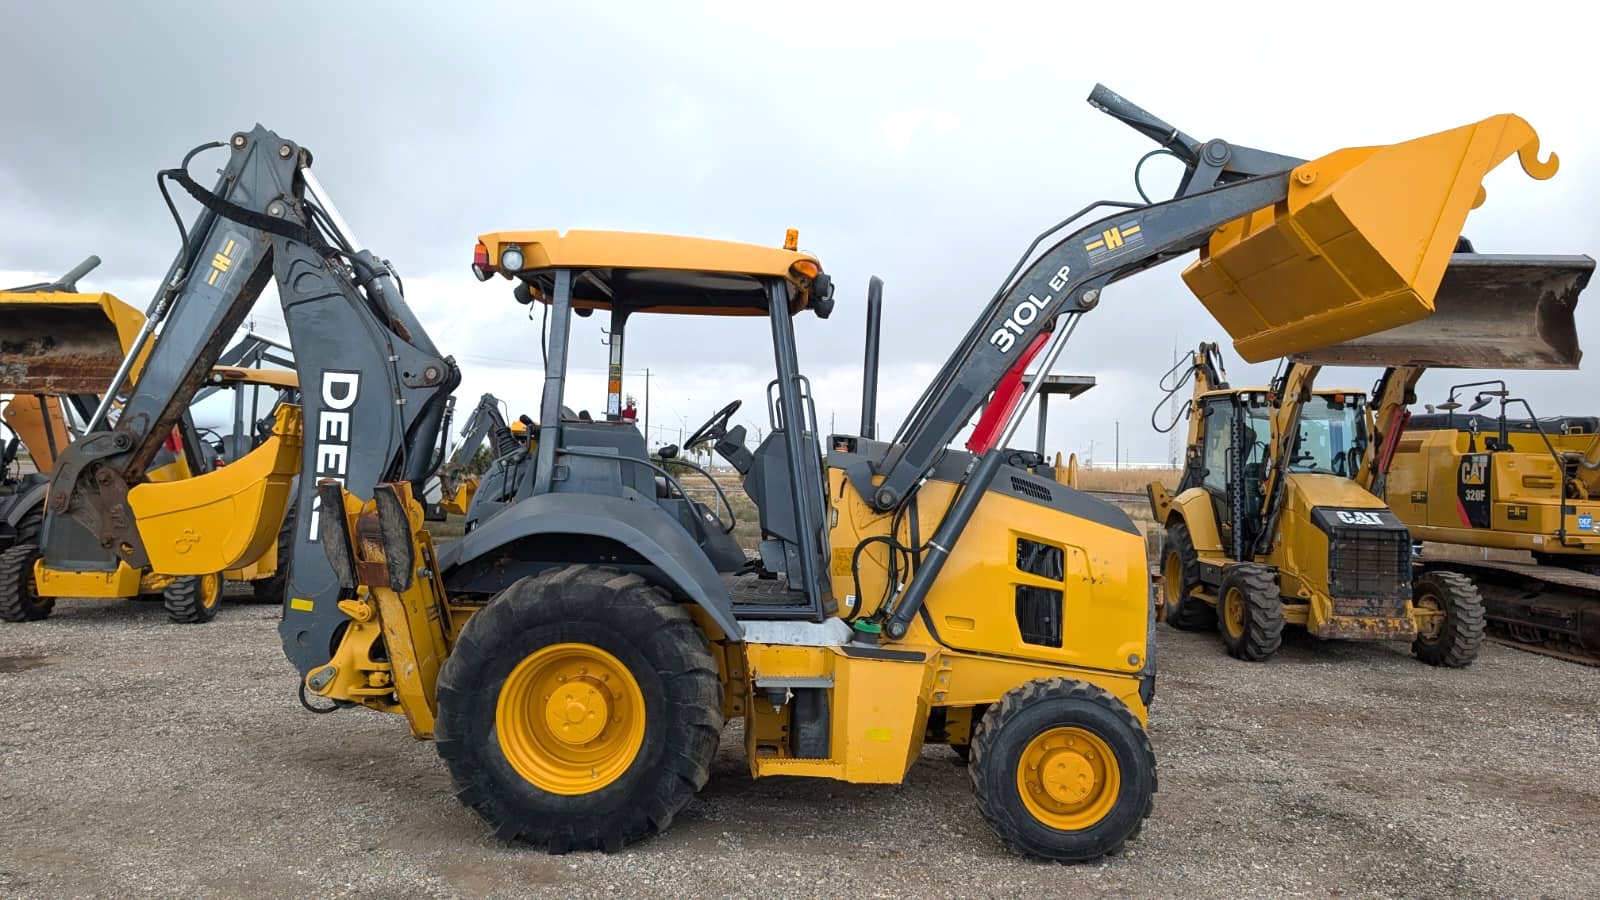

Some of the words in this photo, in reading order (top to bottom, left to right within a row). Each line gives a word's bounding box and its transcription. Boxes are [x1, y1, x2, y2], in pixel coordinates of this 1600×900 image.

[990, 294, 1052, 353] 310L
[1048, 265, 1071, 292] EP
[309, 372, 359, 541] DEE
[1462, 461, 1487, 485] CAT
[1464, 489, 1486, 501] 320F
[1335, 510, 1385, 526] CAT
